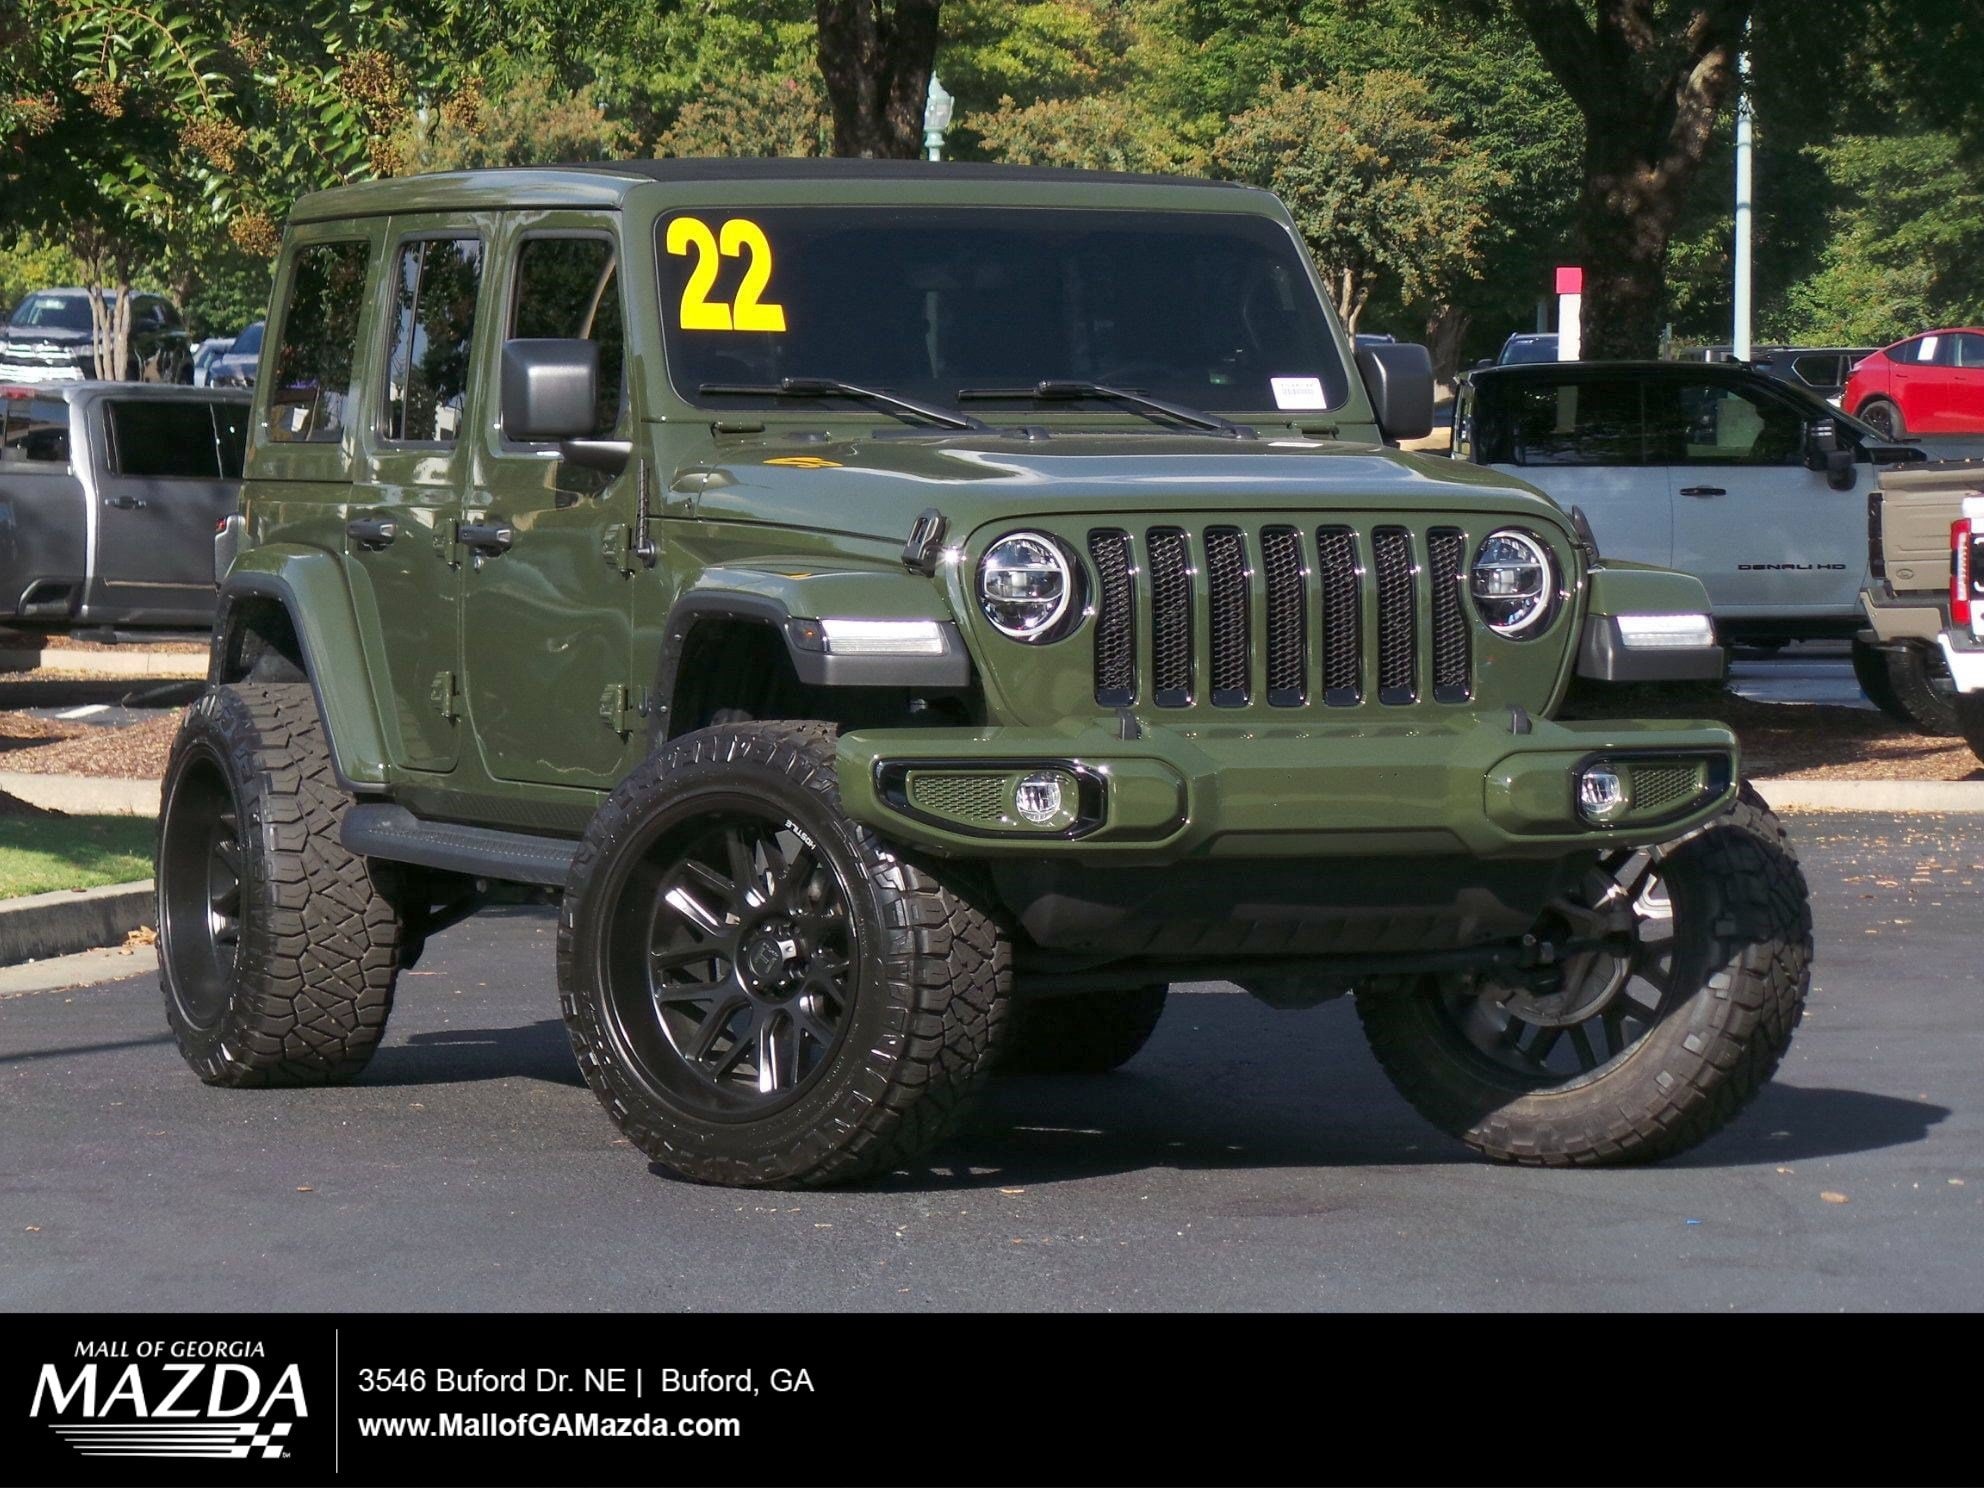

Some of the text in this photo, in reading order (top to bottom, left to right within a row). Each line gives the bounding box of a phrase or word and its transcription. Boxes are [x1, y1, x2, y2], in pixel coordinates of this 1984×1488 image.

[666, 217, 787, 332] 22
[1737, 563, 1847, 571] DENALI HD
[784, 819, 817, 850] HOSTILE
